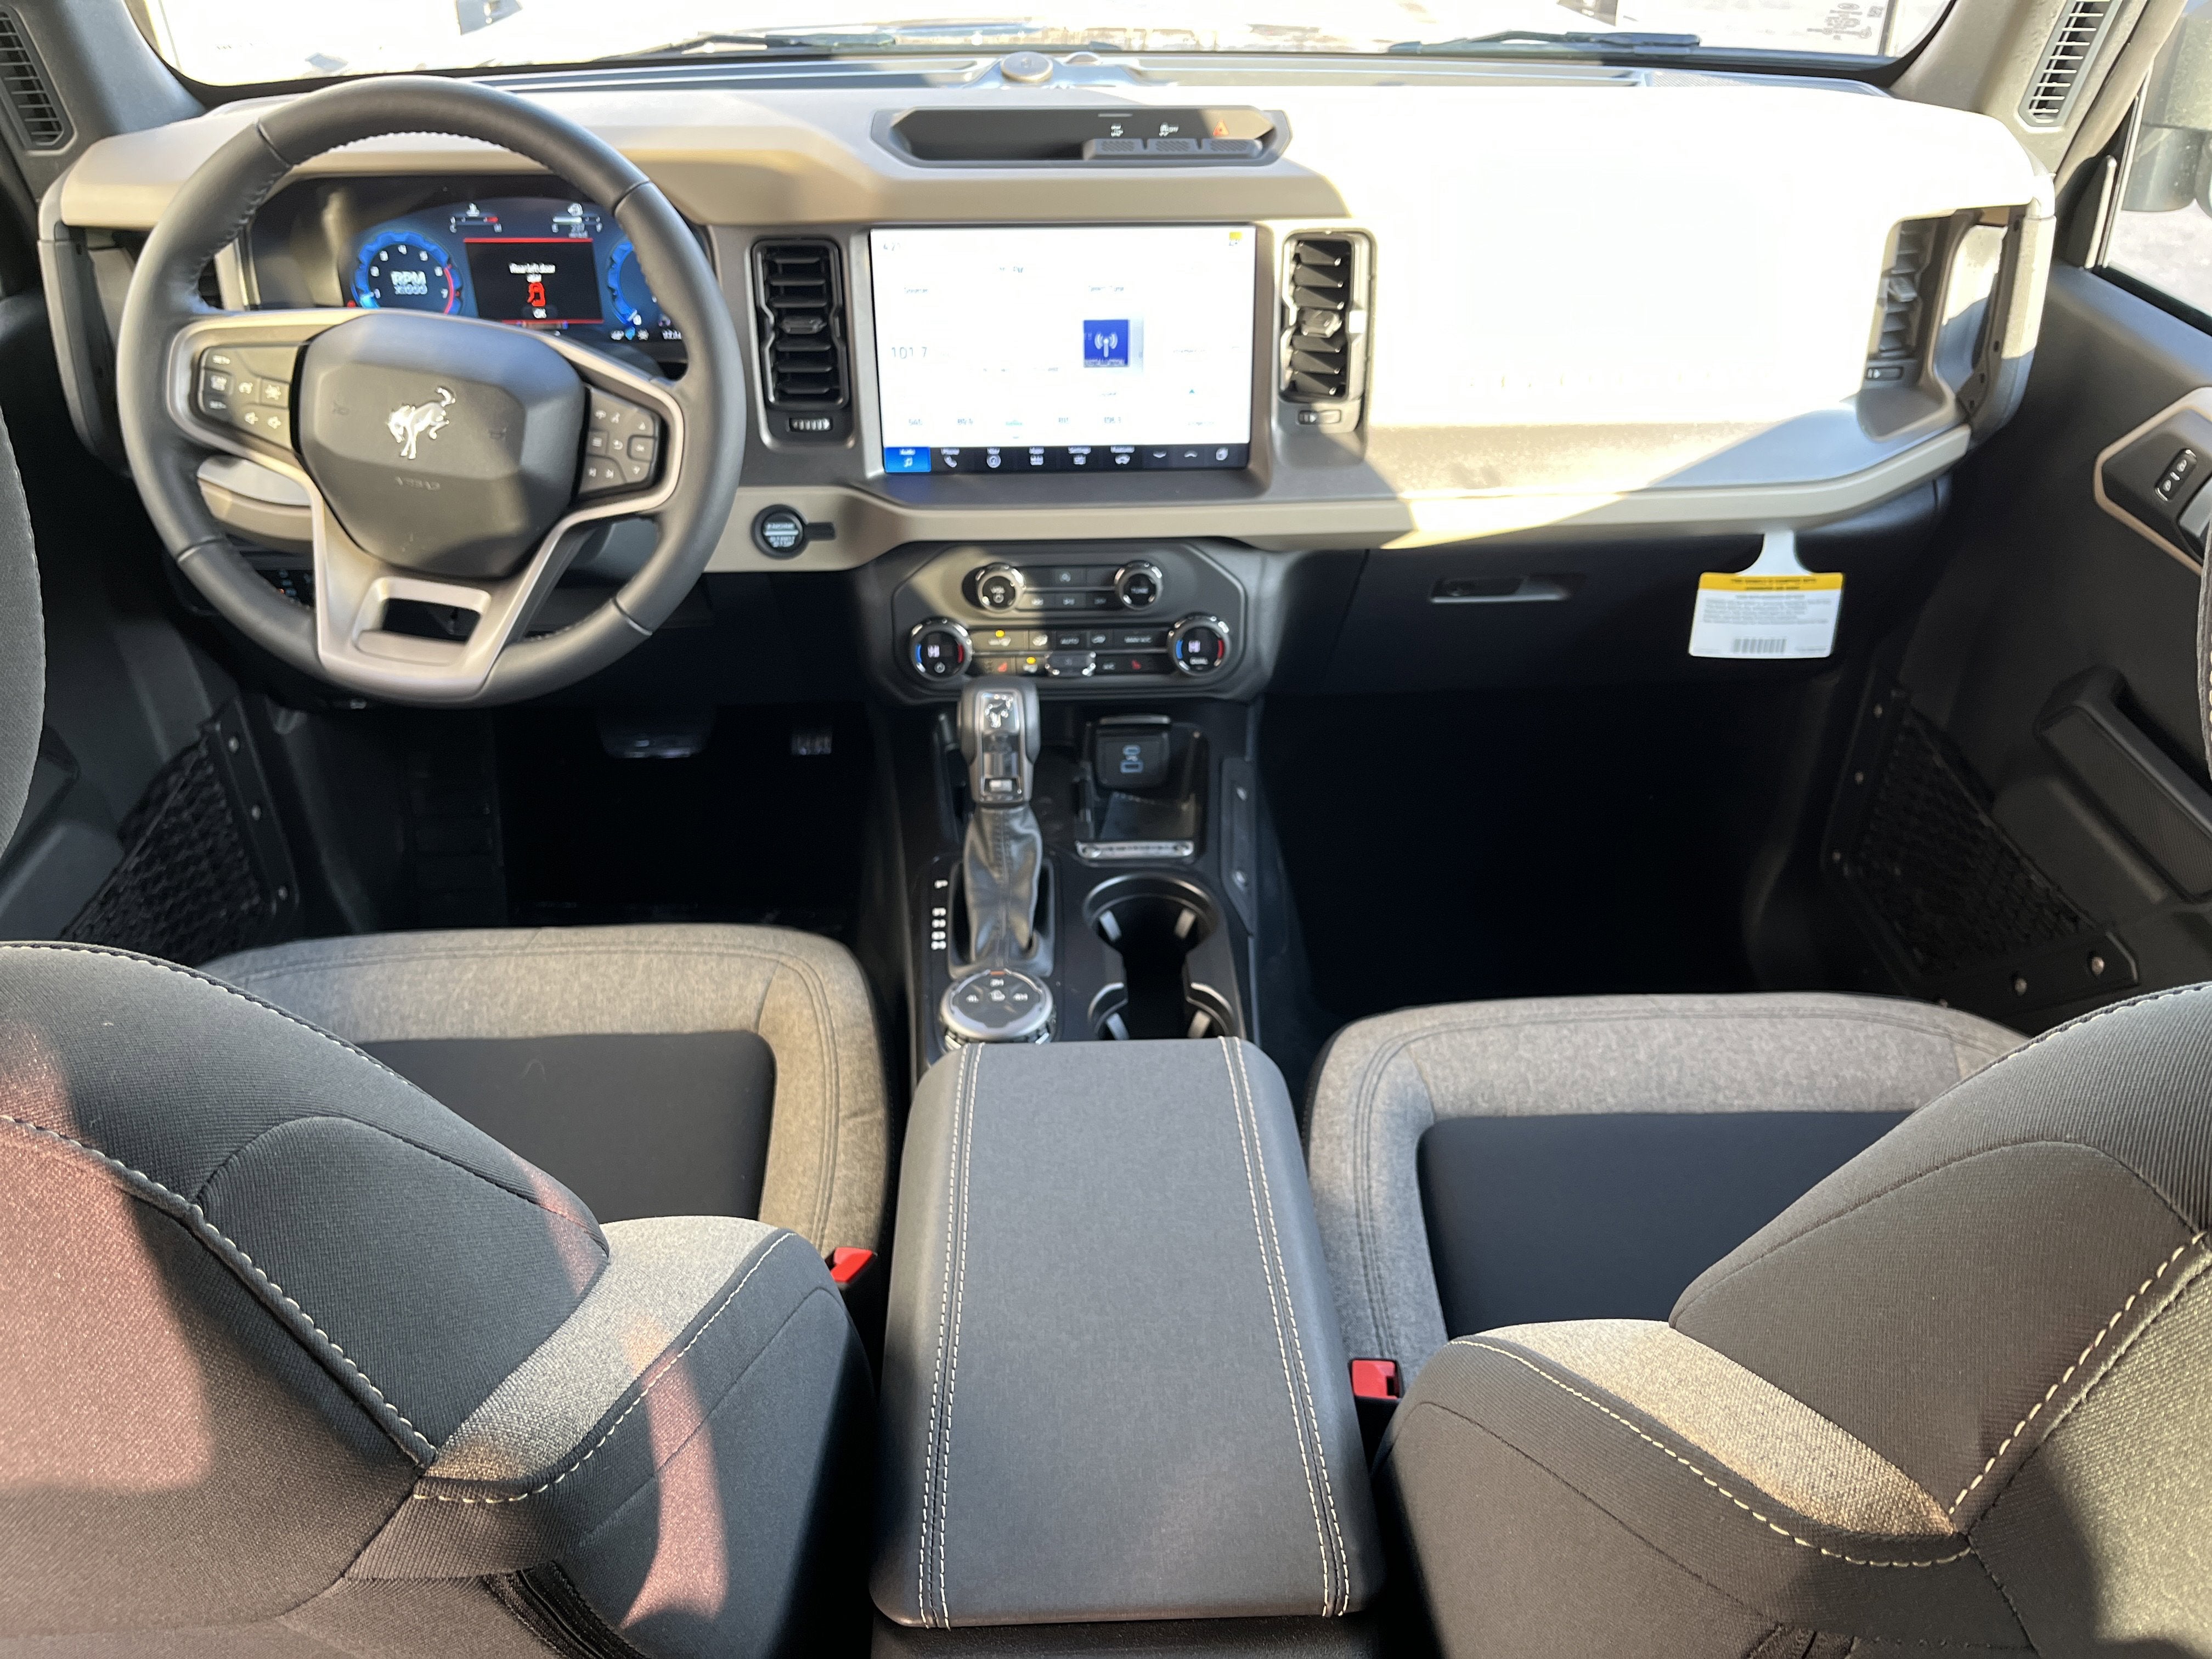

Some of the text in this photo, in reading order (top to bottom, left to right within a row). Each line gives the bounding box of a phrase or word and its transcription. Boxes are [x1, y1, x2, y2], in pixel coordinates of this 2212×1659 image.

[391, 271, 426, 285] RPM
[891, 346, 928, 359] 1017
[1060, 637, 1080, 645] AUTO
